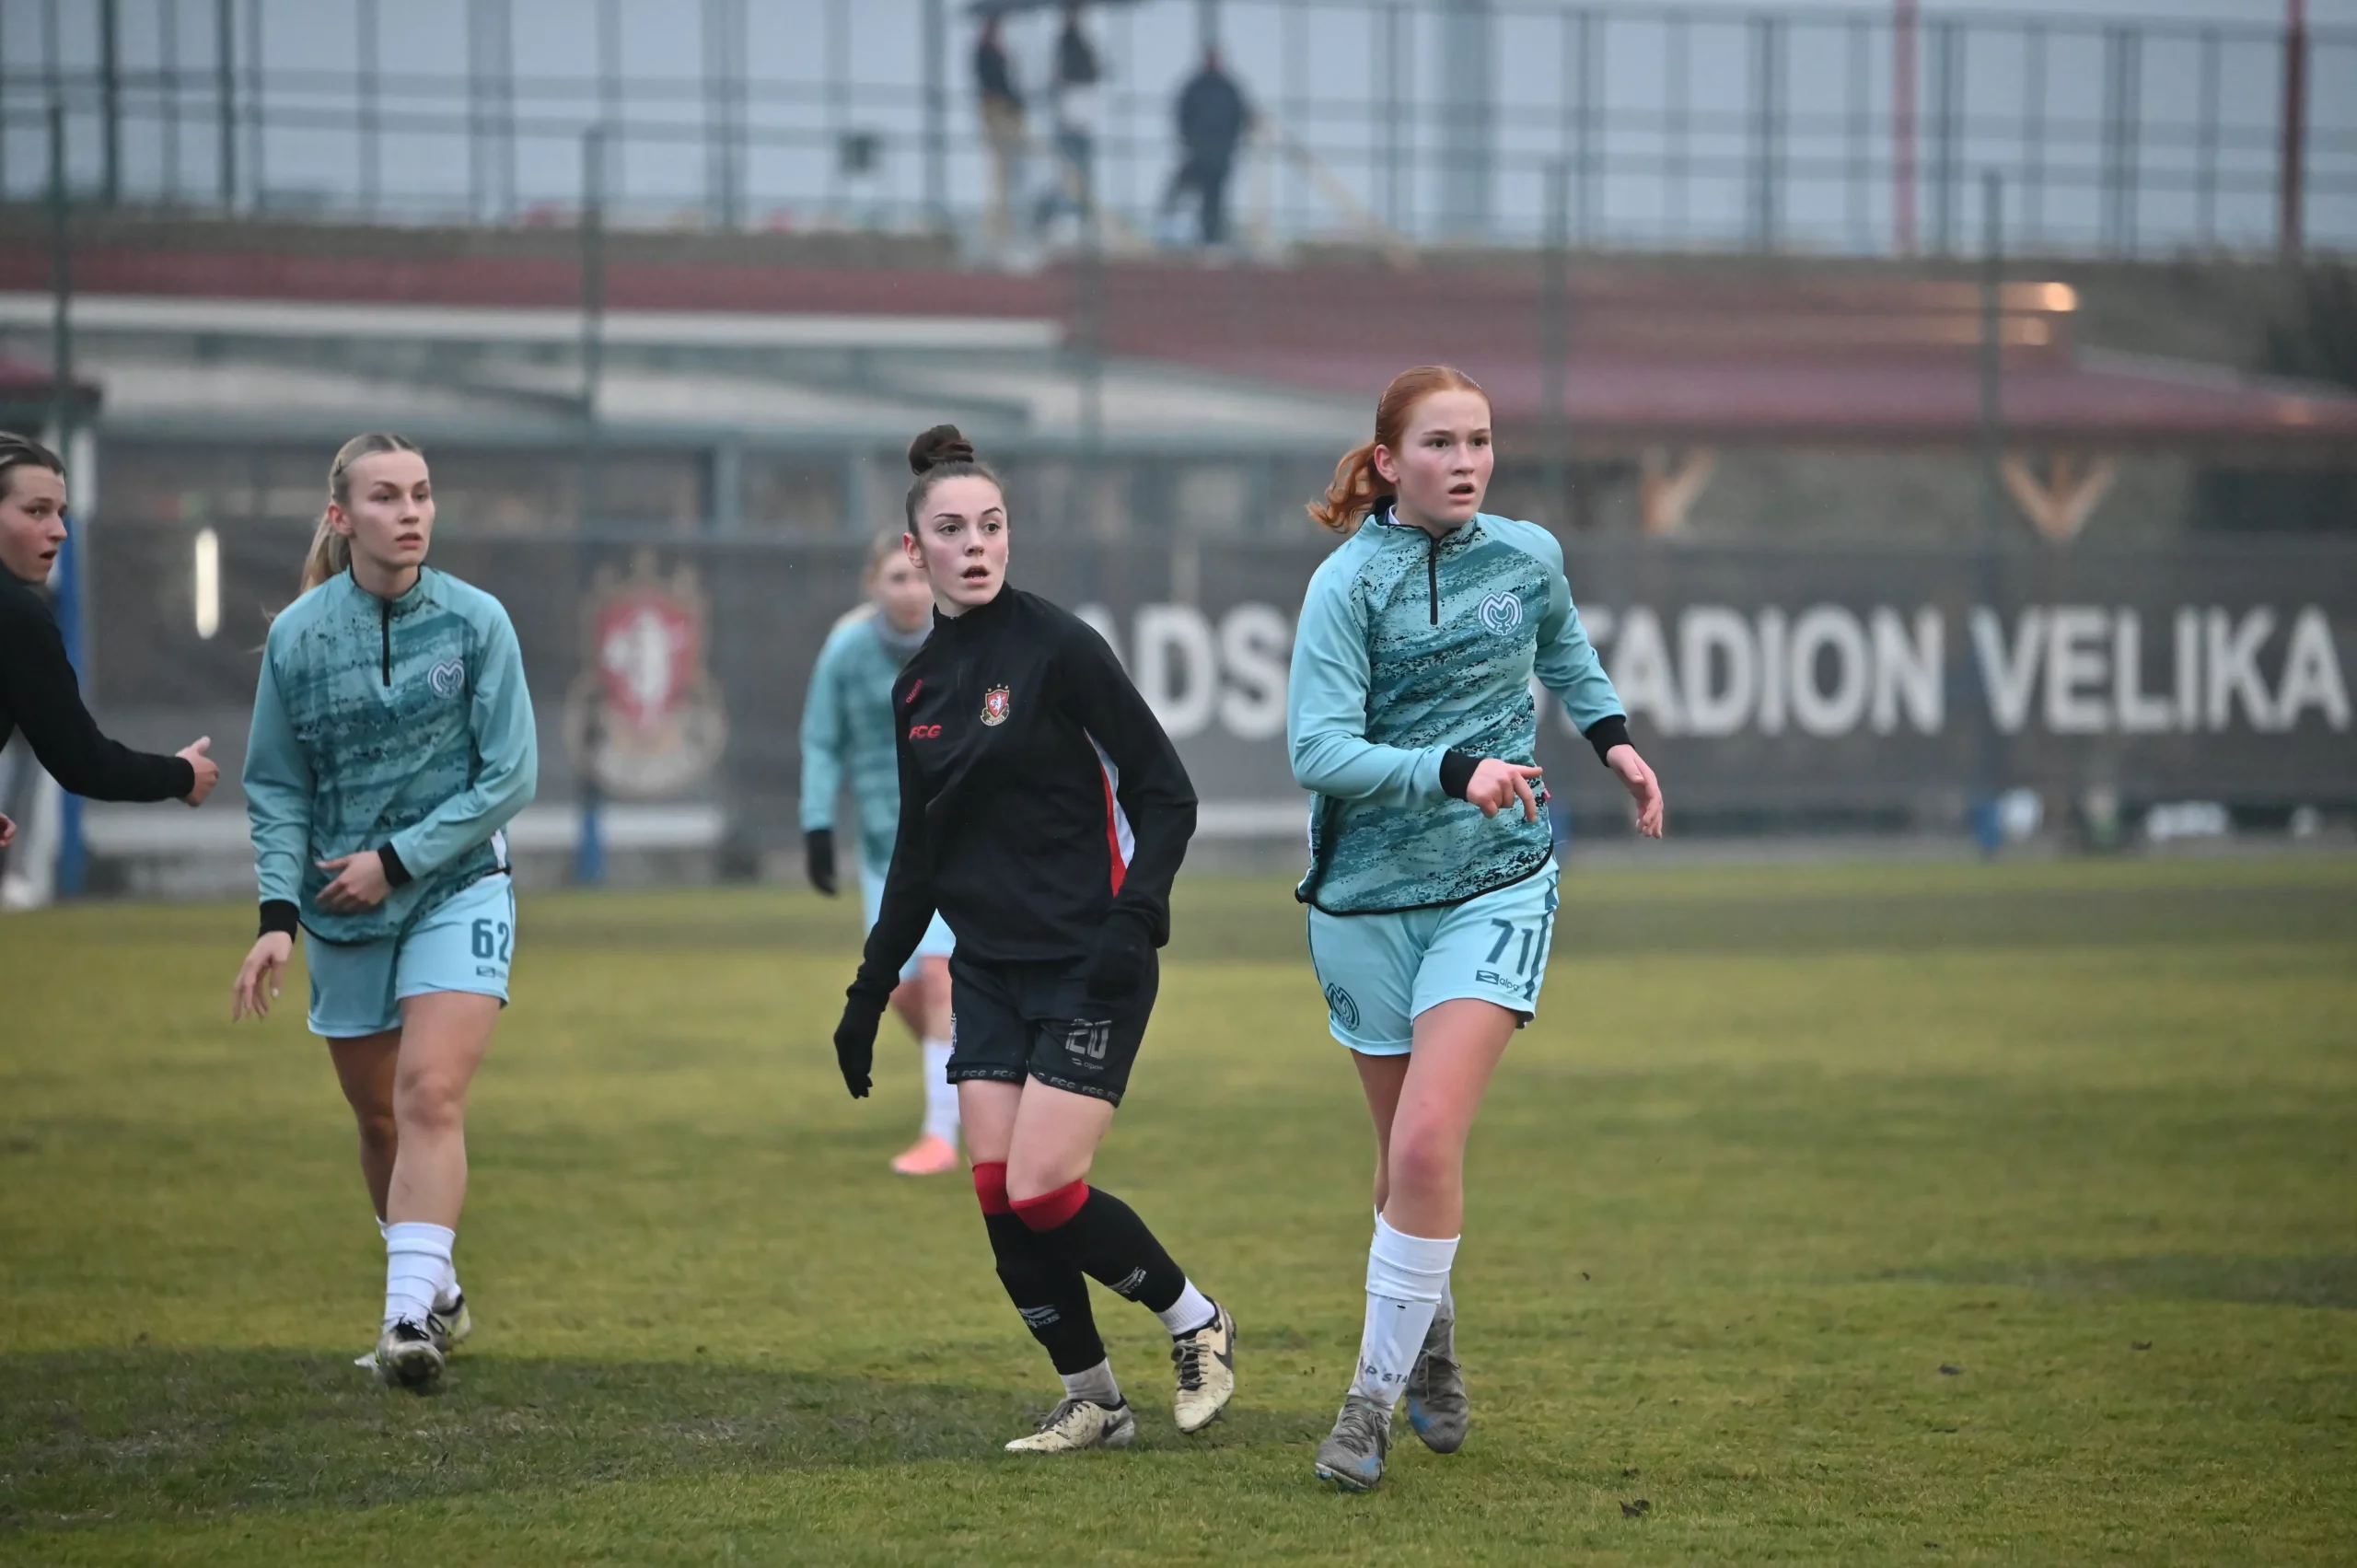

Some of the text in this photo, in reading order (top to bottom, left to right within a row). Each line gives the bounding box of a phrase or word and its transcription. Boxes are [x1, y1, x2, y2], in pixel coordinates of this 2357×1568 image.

[1533, 604, 1946, 736] ADION
[1969, 604, 2351, 736] VELIKA
[908, 724, 942, 740] FCG
[471, 919, 509, 965] 62
[1485, 917, 1534, 977] 71
[1064, 1018, 1112, 1060] 20
